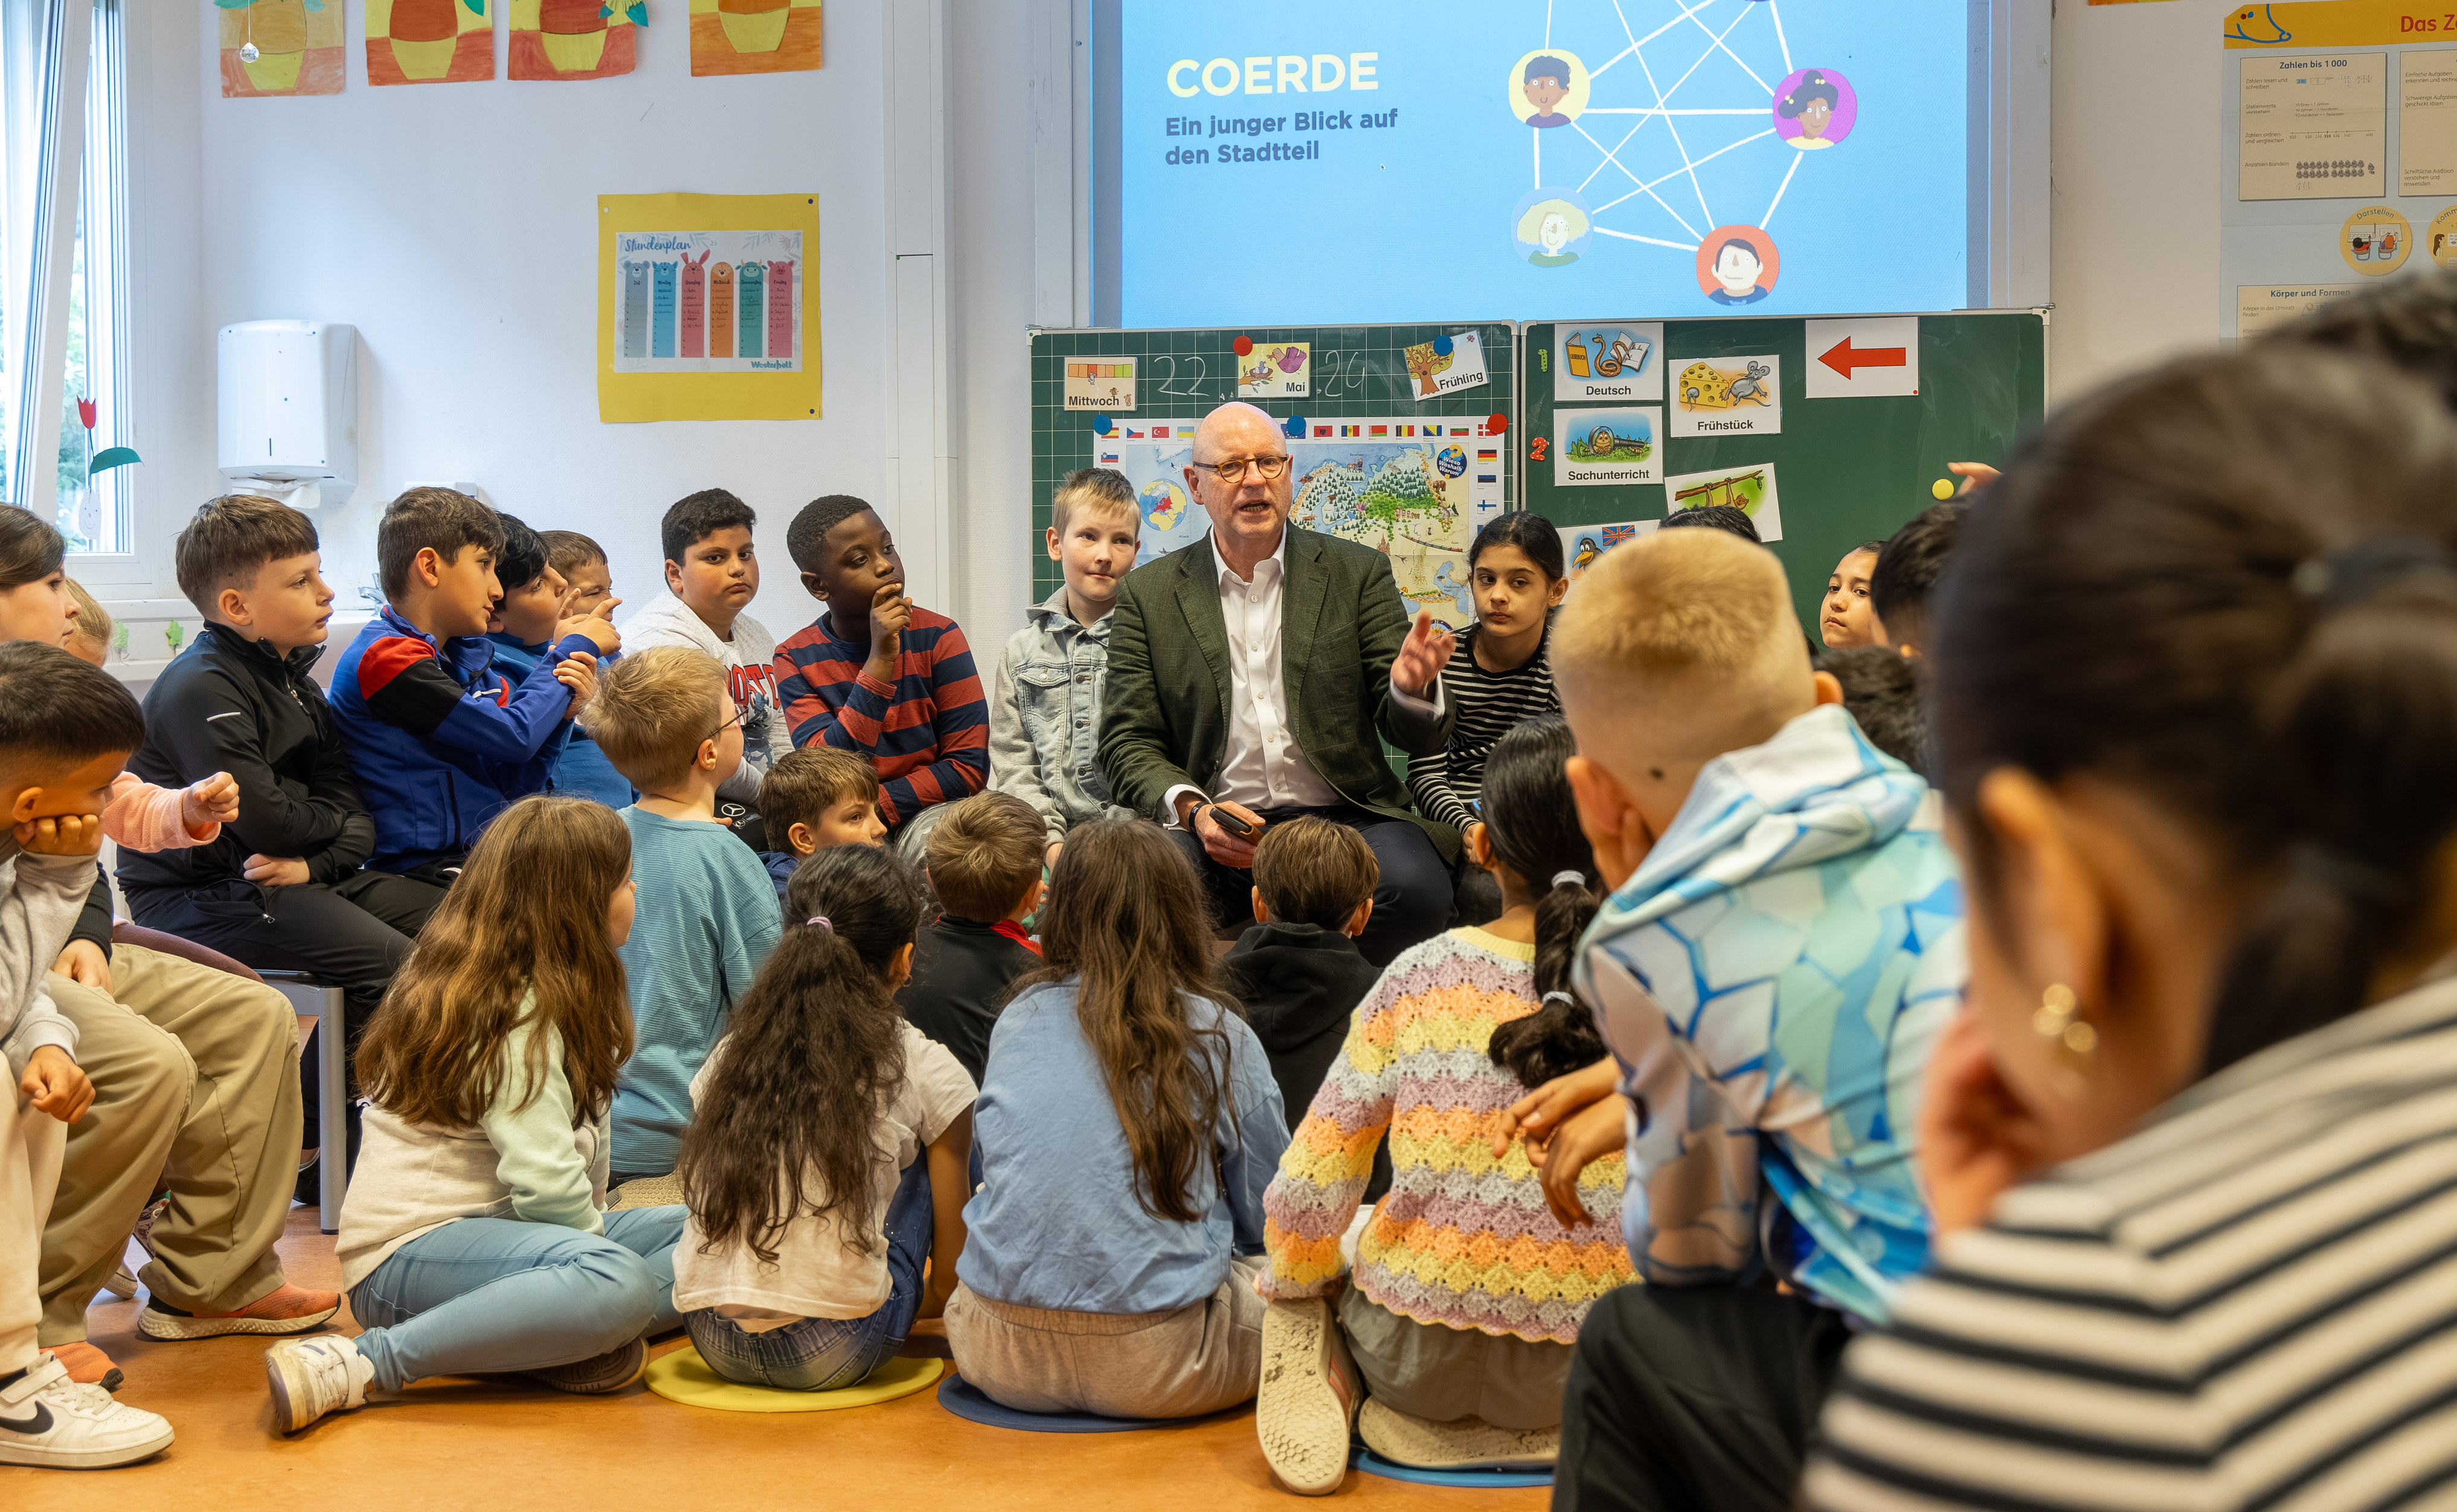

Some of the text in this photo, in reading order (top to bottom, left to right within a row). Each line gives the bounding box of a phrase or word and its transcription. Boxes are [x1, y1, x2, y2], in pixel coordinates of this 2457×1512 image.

[2401, 14, 2457, 33] Das Z
[2279, 61, 2308, 69] Zahlen
[1166, 52, 1379, 98] COERDE
[1166, 108, 1398, 138] Ein junger Blick auf
[1165, 140, 1320, 165] den Stadtteil
[2356, 208, 2394, 220] Darstellen
[625, 235, 692, 254] Stundenplan
[2270, 290, 2299, 299] Körper
[751, 359, 792, 370] Westerholt
[1538, 349, 1548, 373] 1
[1439, 372, 1483, 389] Frühling
[1286, 382, 1305, 392] Mai
[1586, 386, 1631, 395] Deutsch
[1068, 396, 1119, 406] Mittwoch
[1697, 420, 1753, 431] Frühstück
[1529, 437, 1547, 461] 2
[1439, 460, 1462, 472] Weshalb
[1444, 456, 1460, 466] Wieso
[1439, 466, 1459, 476] Warum
[1568, 469, 1649, 480] Sachunterricht
